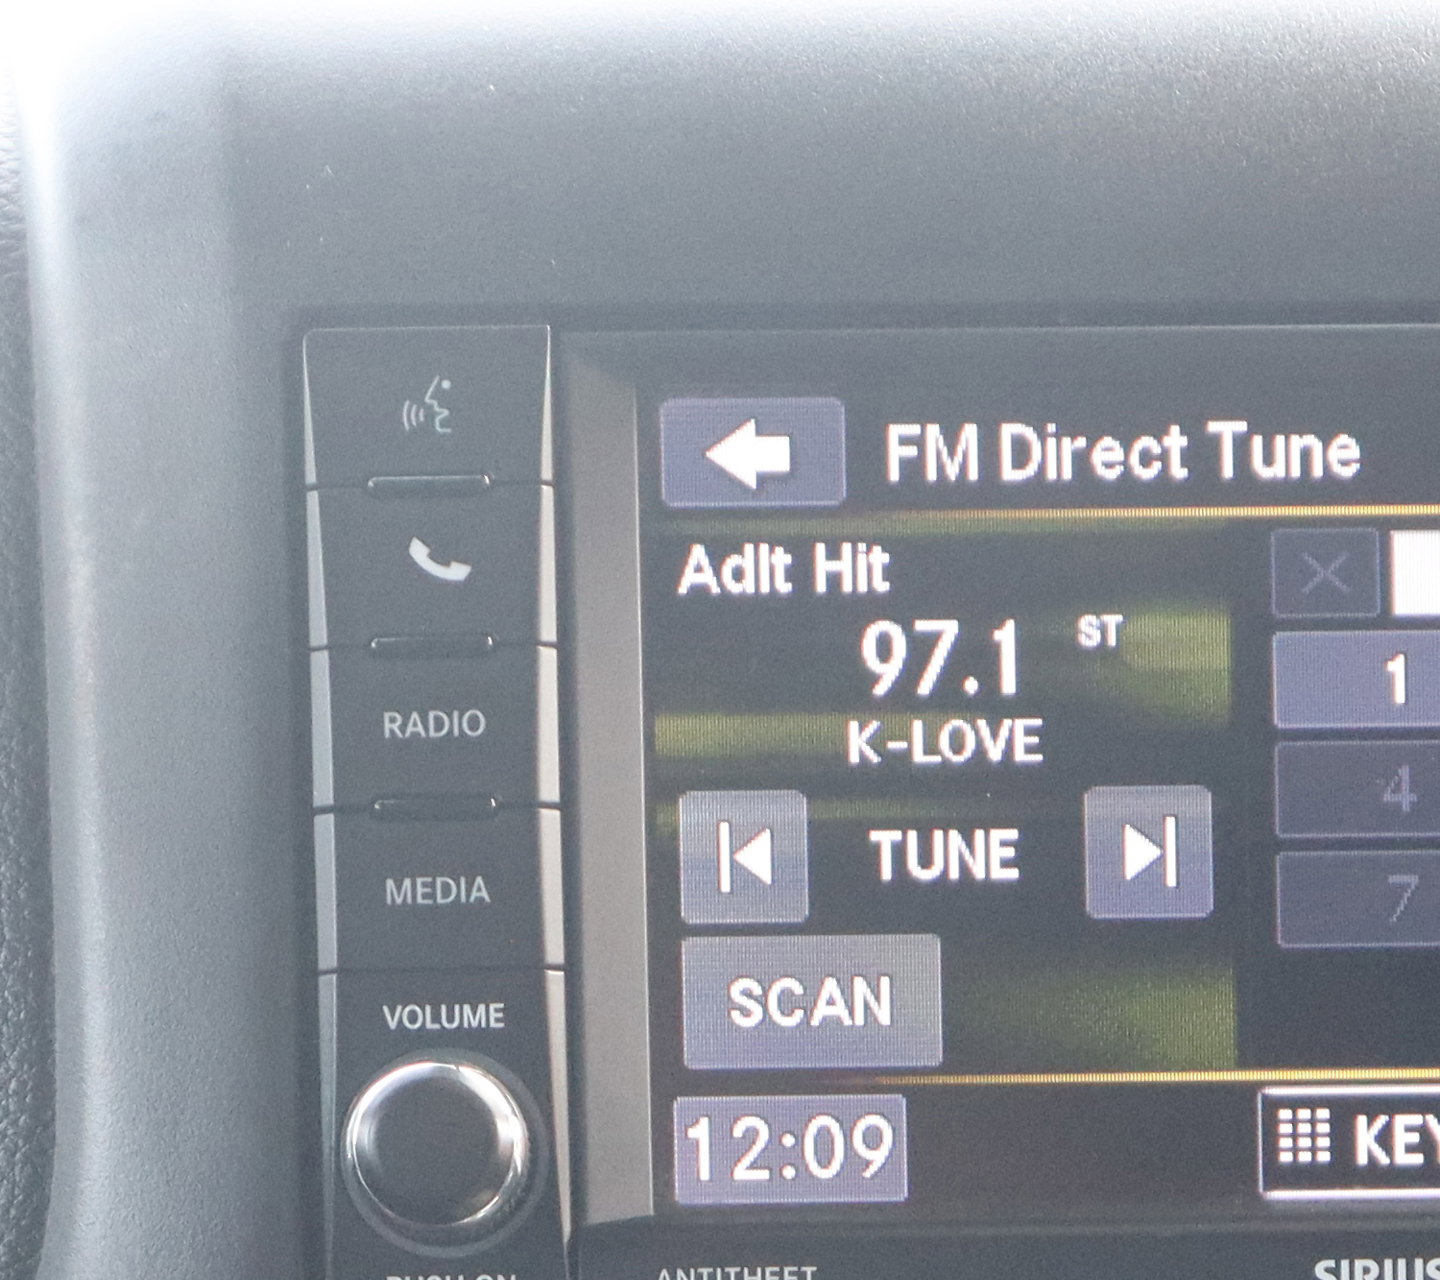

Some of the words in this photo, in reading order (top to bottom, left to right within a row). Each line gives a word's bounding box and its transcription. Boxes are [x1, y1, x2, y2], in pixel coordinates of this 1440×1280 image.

[886, 423, 982, 482] FM
[1000, 421, 1187, 482] Direct
[1207, 421, 1362, 480] Tune
[813, 541, 891, 595] Hit
[1076, 613, 1123, 649] ST
[859, 618, 1020, 697] 97.1
[1385, 653, 1408, 706] 1
[383, 709, 487, 739] RADIO
[846, 718, 1045, 766] K-LOVE
[1382, 763, 1418, 814] 4
[869, 828, 1021, 882] TUNE
[384, 875, 491, 906] MEDIA
[1385, 873, 1420, 923] 7
[382, 1003, 506, 1031] VOLUME
[727, 975, 892, 1029] SCAN
[685, 1115, 895, 1182] 12:09
